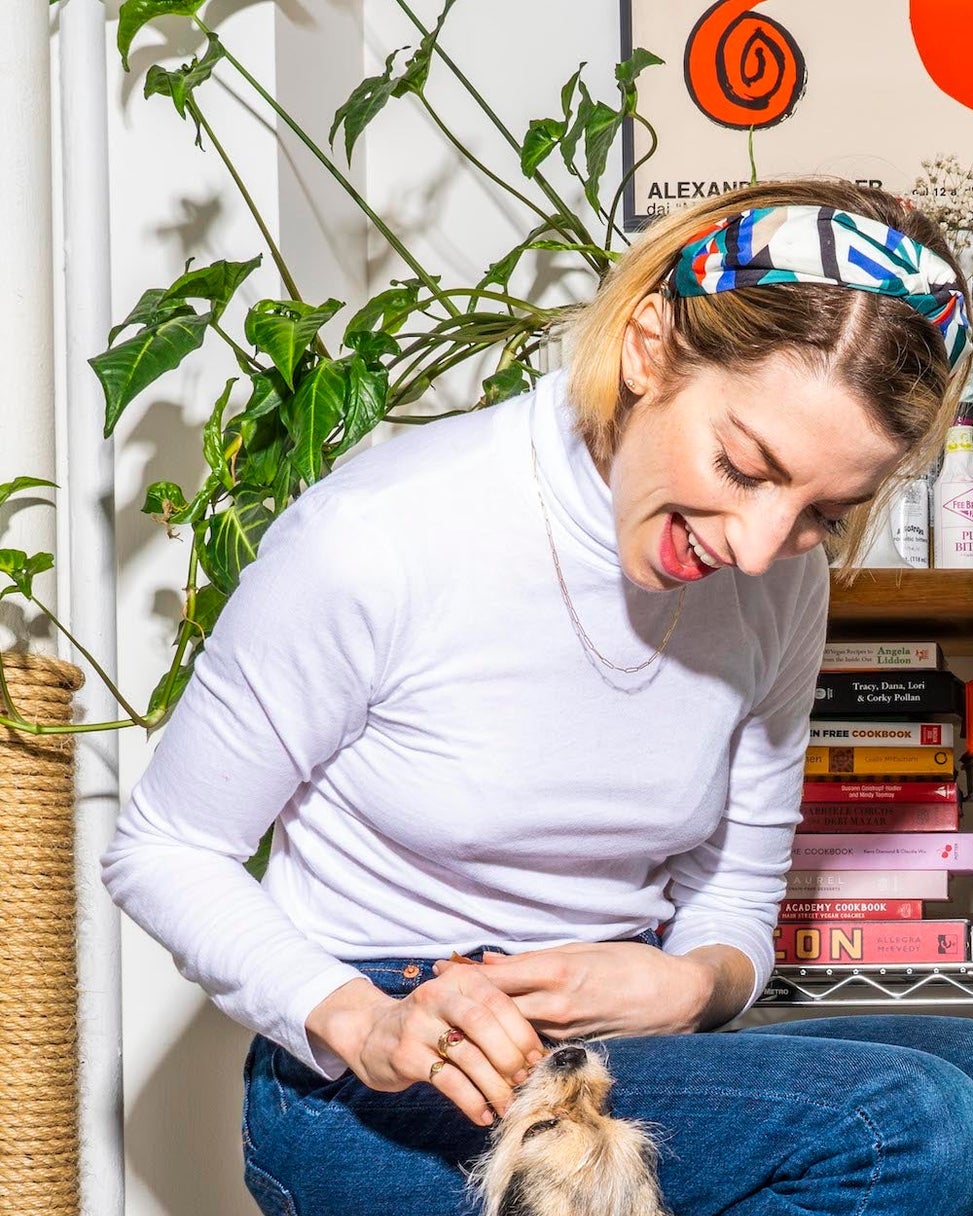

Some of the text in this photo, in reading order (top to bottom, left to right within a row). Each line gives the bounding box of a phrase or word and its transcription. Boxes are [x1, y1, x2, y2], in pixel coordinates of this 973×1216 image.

[934, 187, 946, 197] 12
[953, 501, 965, 509] FEE
[877, 646, 911, 657] Angela
[877, 656, 911, 665] Liddon
[852, 681, 926, 691] Tracy, Dana, Lori
[857, 693, 921, 704] & Corky Pollan
[823, 729, 849, 738] FREE
[852, 730, 912, 739] COOKBOOK
[785, 903, 887, 912] ACADEMY COOKBOOK
[876, 936, 921, 944] ALLEGRA
